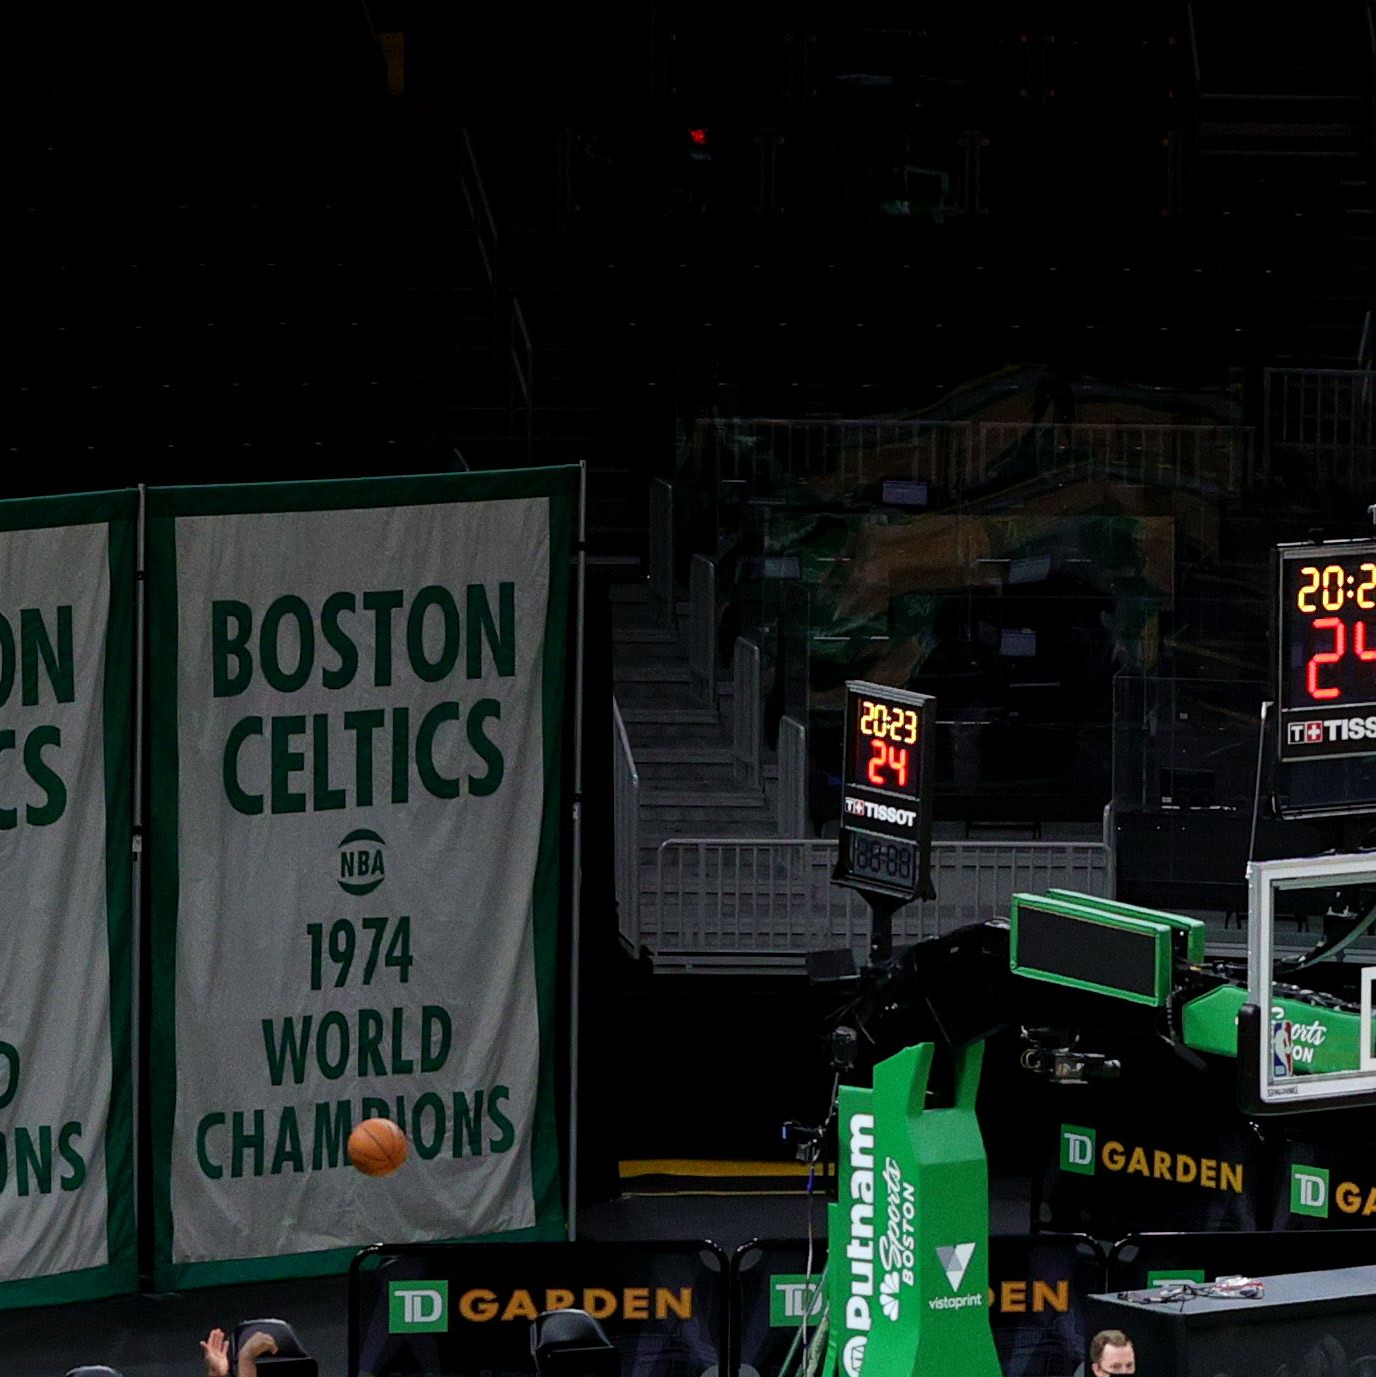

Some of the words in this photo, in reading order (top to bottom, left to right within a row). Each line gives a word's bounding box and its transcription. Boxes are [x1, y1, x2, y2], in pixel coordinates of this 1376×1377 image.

[212, 582, 516, 698] BOSTON
[861, 701, 917, 744] 20:23
[222, 698, 505, 815] CELTICS
[868, 739, 908, 787] 24
[865, 801, 917, 827] TISSOT
[341, 850, 385, 877] NBA
[307, 916, 413, 990] 1974
[261, 1005, 452, 1086] WORLD
[1064, 1133, 1092, 1165] TD
[1101, 1141, 1243, 1194] GARDEN
[1294, 1173, 1326, 1207] TD
[846, 1113, 875, 1332] Putnam
[879, 1157, 903, 1272] Sports
[902, 1182, 916, 1287] BOSTON
[394, 1289, 443, 1323] TD
[459, 1287, 693, 1323] GARDEN
[928, 1293, 983, 1311] vistaprint
